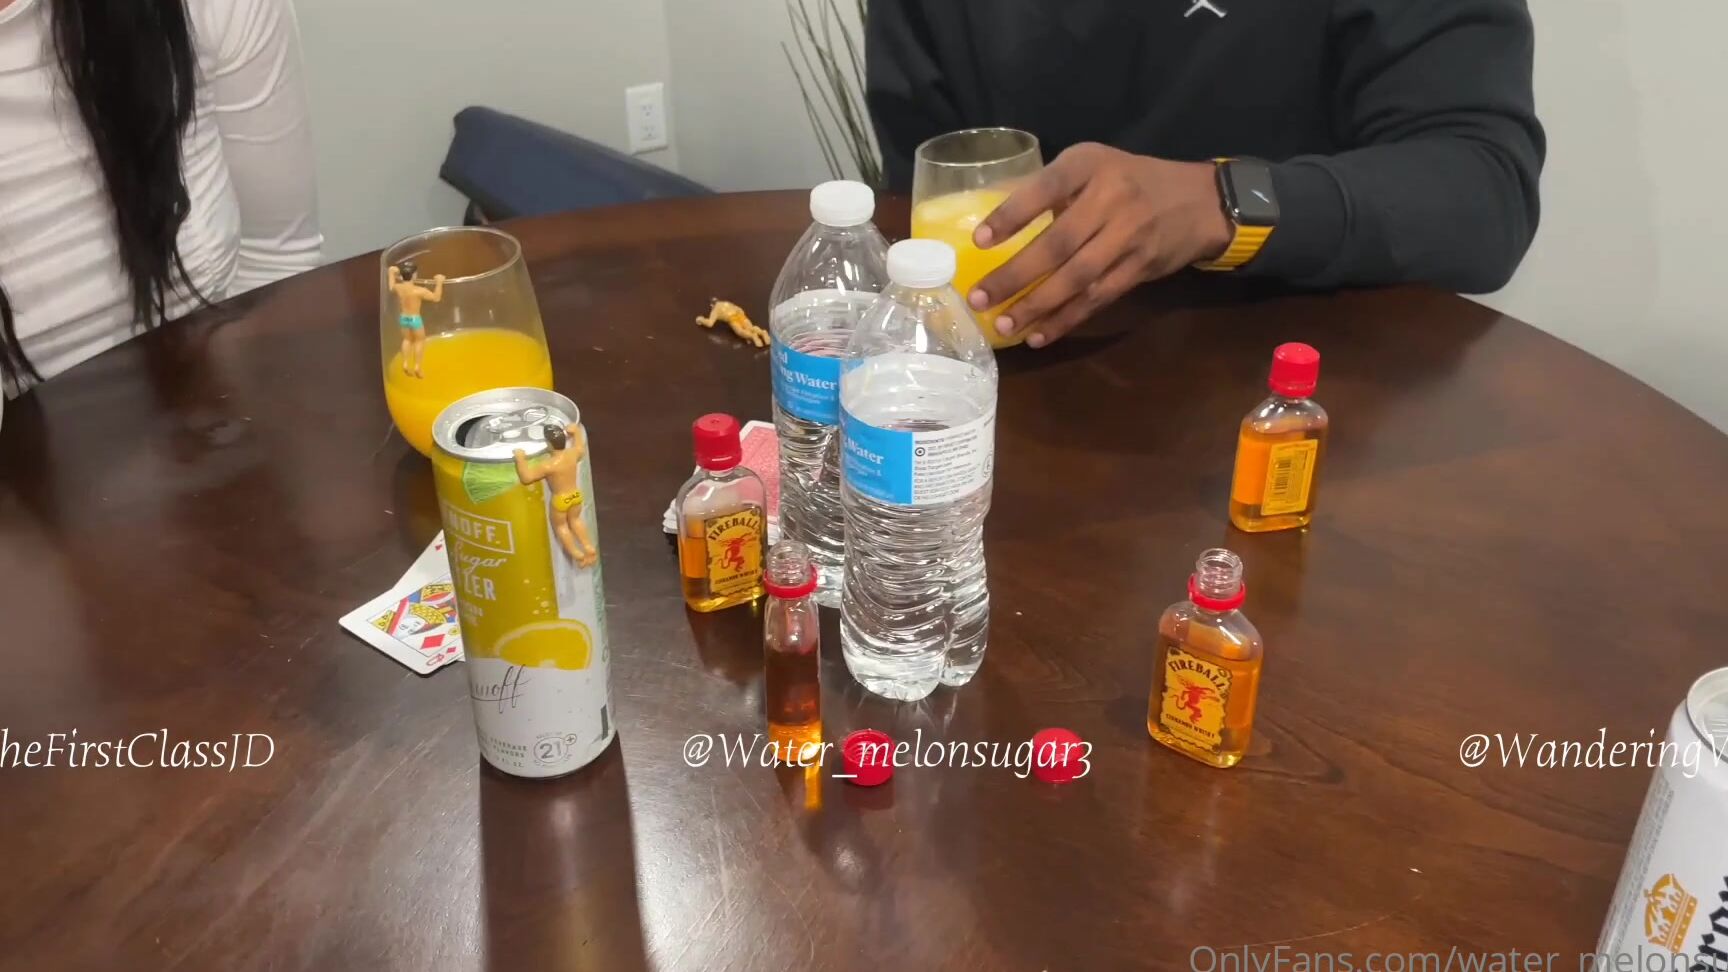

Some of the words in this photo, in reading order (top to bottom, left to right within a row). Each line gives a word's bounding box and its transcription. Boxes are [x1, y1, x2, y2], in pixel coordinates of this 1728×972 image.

[795, 371, 837, 390] Water
[848, 437, 885, 465] Water
[708, 517, 759, 541] FIREBALL
[1168, 659, 1225, 690] FIREBALL
